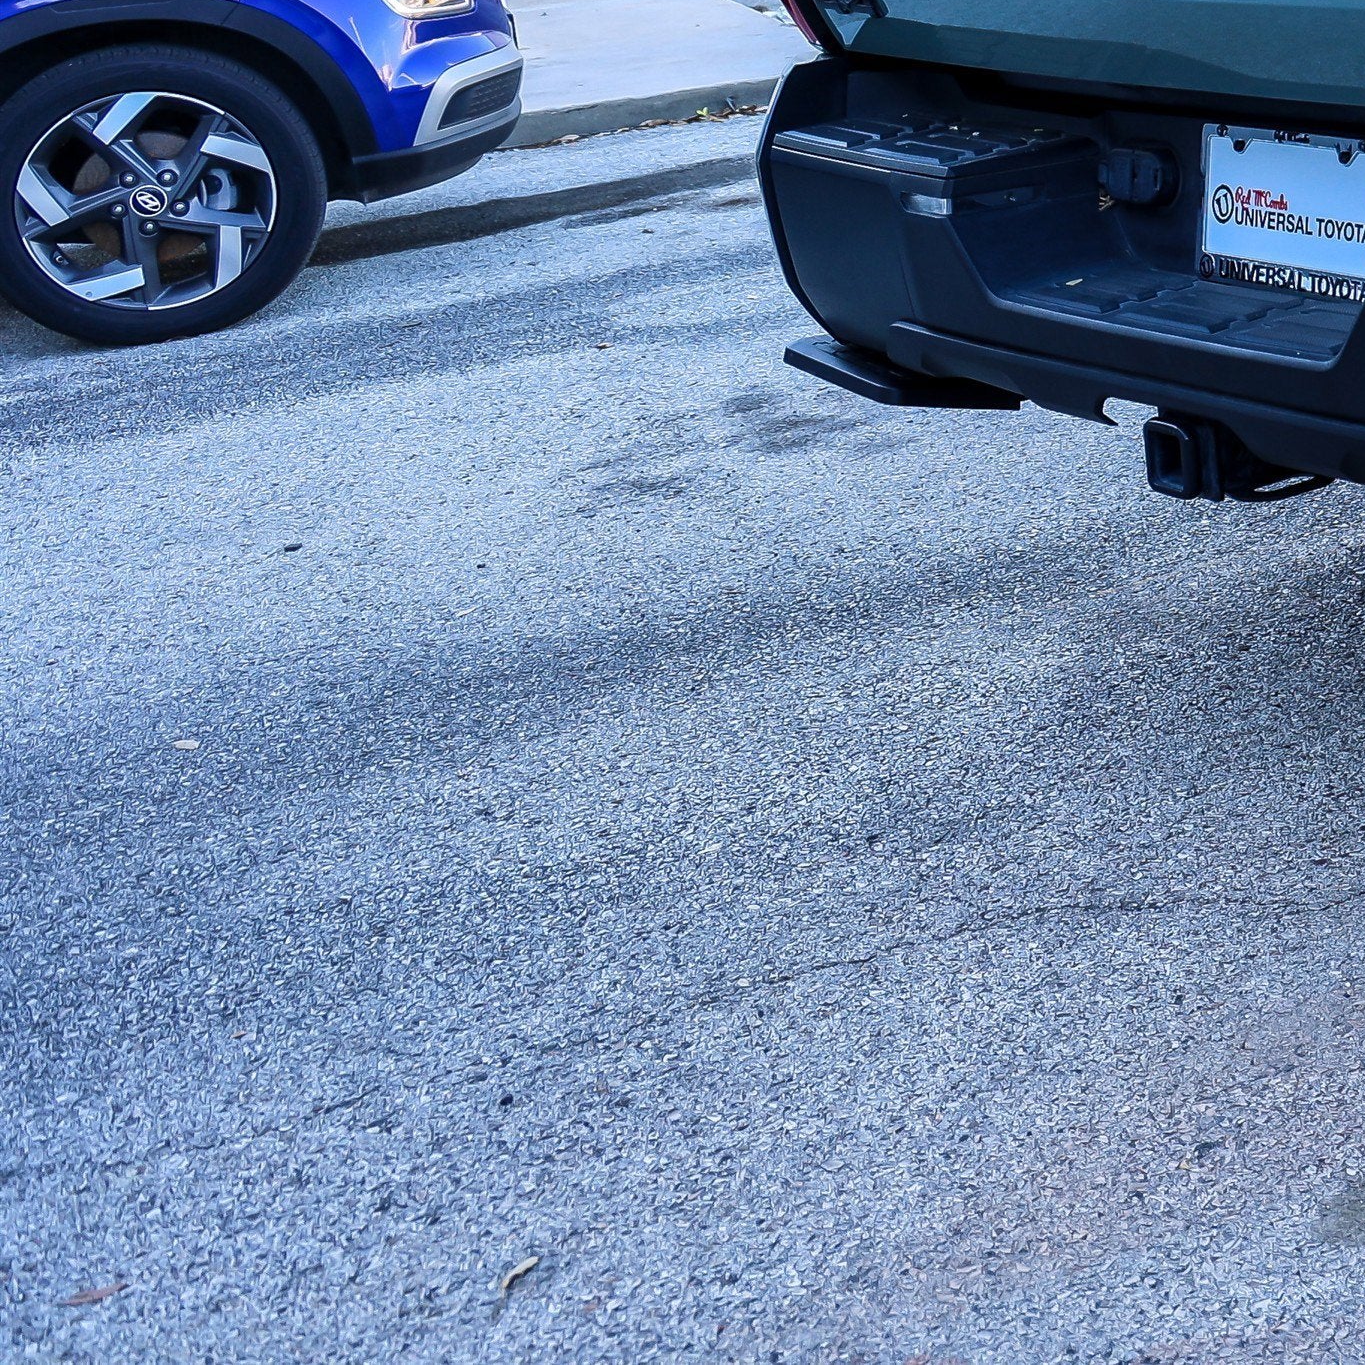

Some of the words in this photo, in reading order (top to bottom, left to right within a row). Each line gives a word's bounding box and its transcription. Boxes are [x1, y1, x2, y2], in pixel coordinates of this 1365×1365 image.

[1235, 187, 1252, 208] Red
[1235, 206, 1313, 235] UNIVERSAL
[1219, 257, 1309, 292] UNIVERSAL
